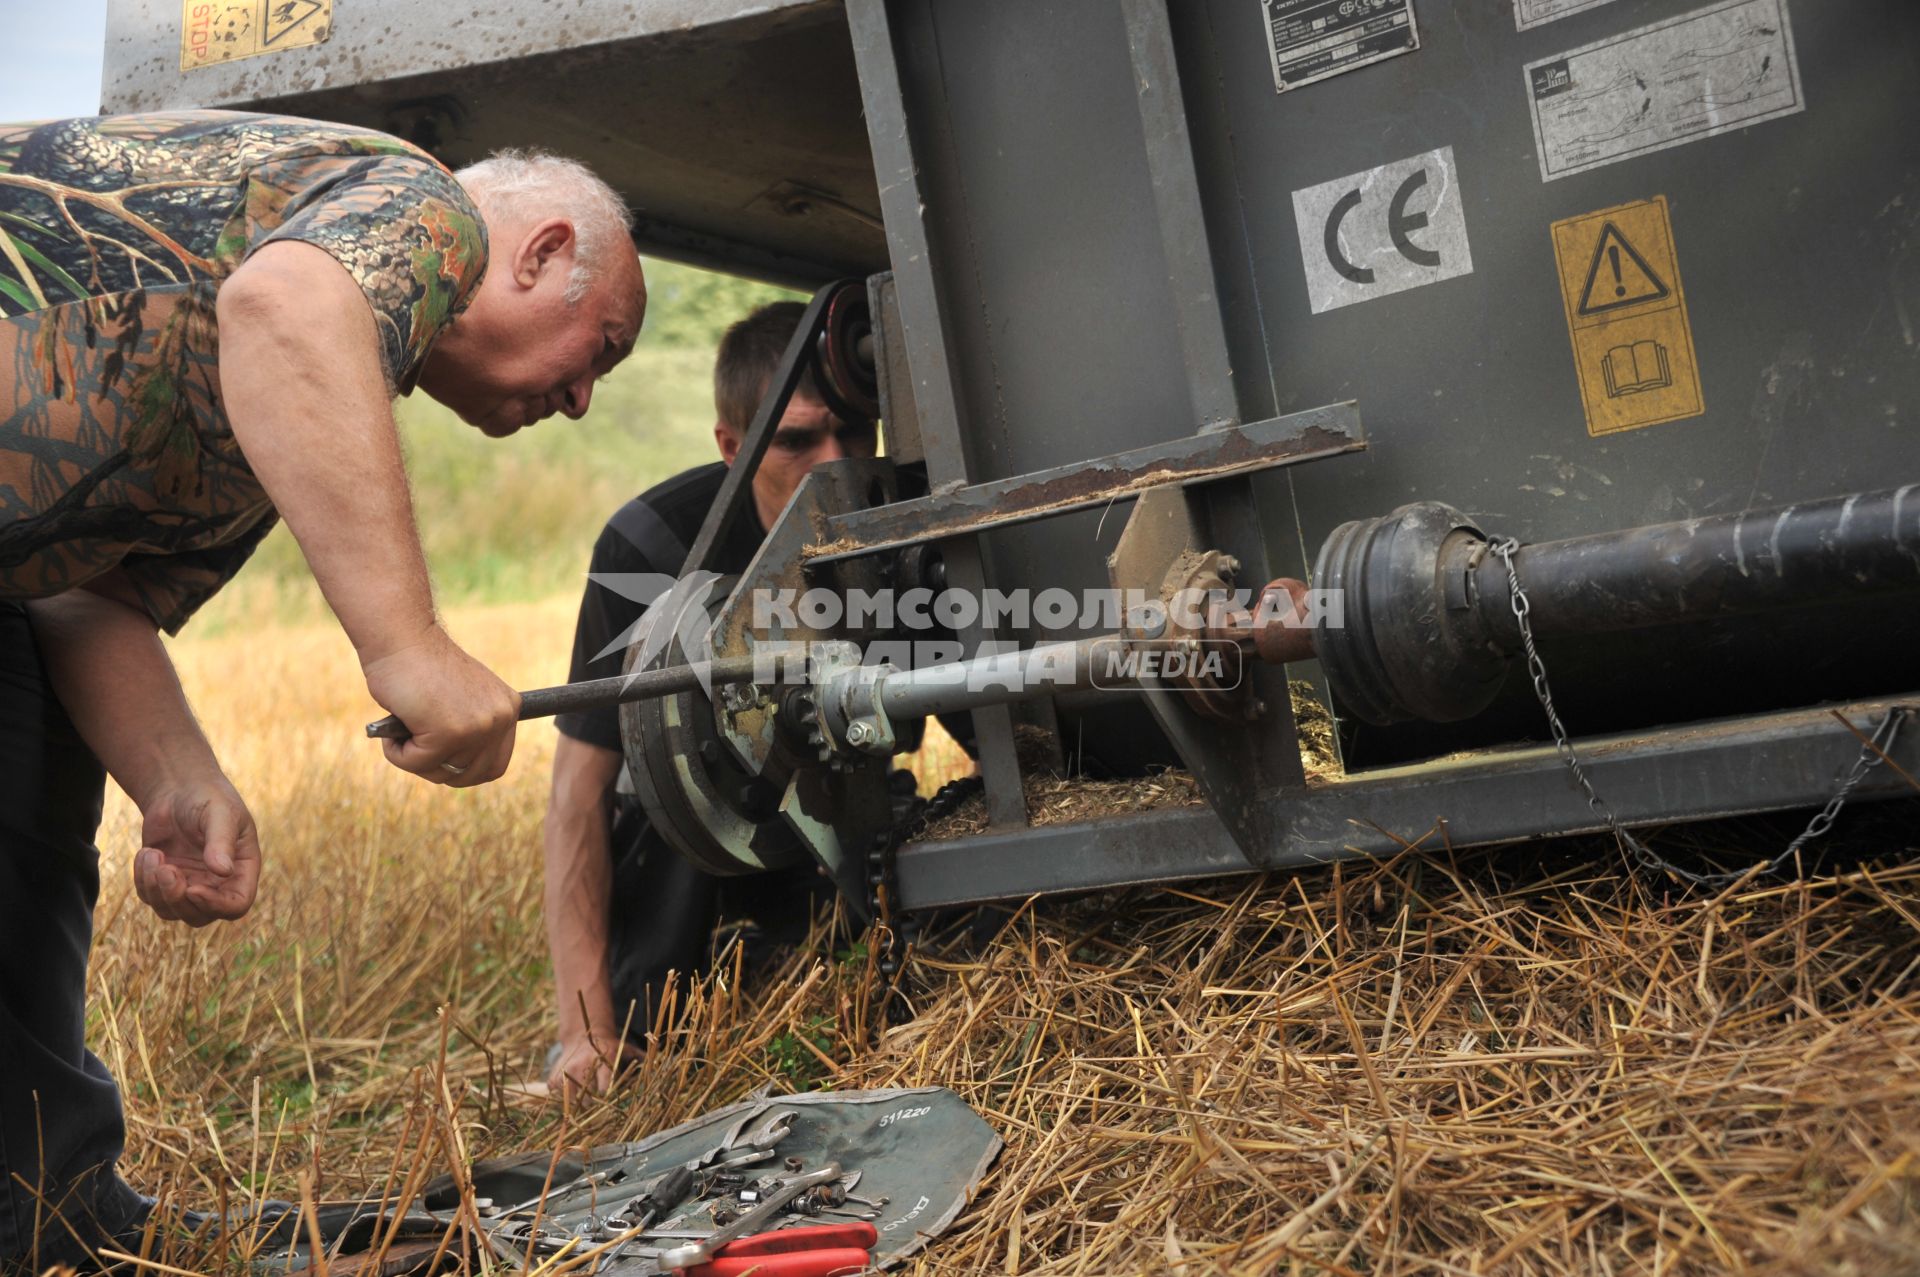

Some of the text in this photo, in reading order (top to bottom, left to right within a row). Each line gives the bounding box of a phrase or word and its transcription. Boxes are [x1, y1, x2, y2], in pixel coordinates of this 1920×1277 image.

[191, 5, 209, 58] STOP
[1324, 169, 1440, 283] CE
[879, 1106, 931, 1127] 511220
